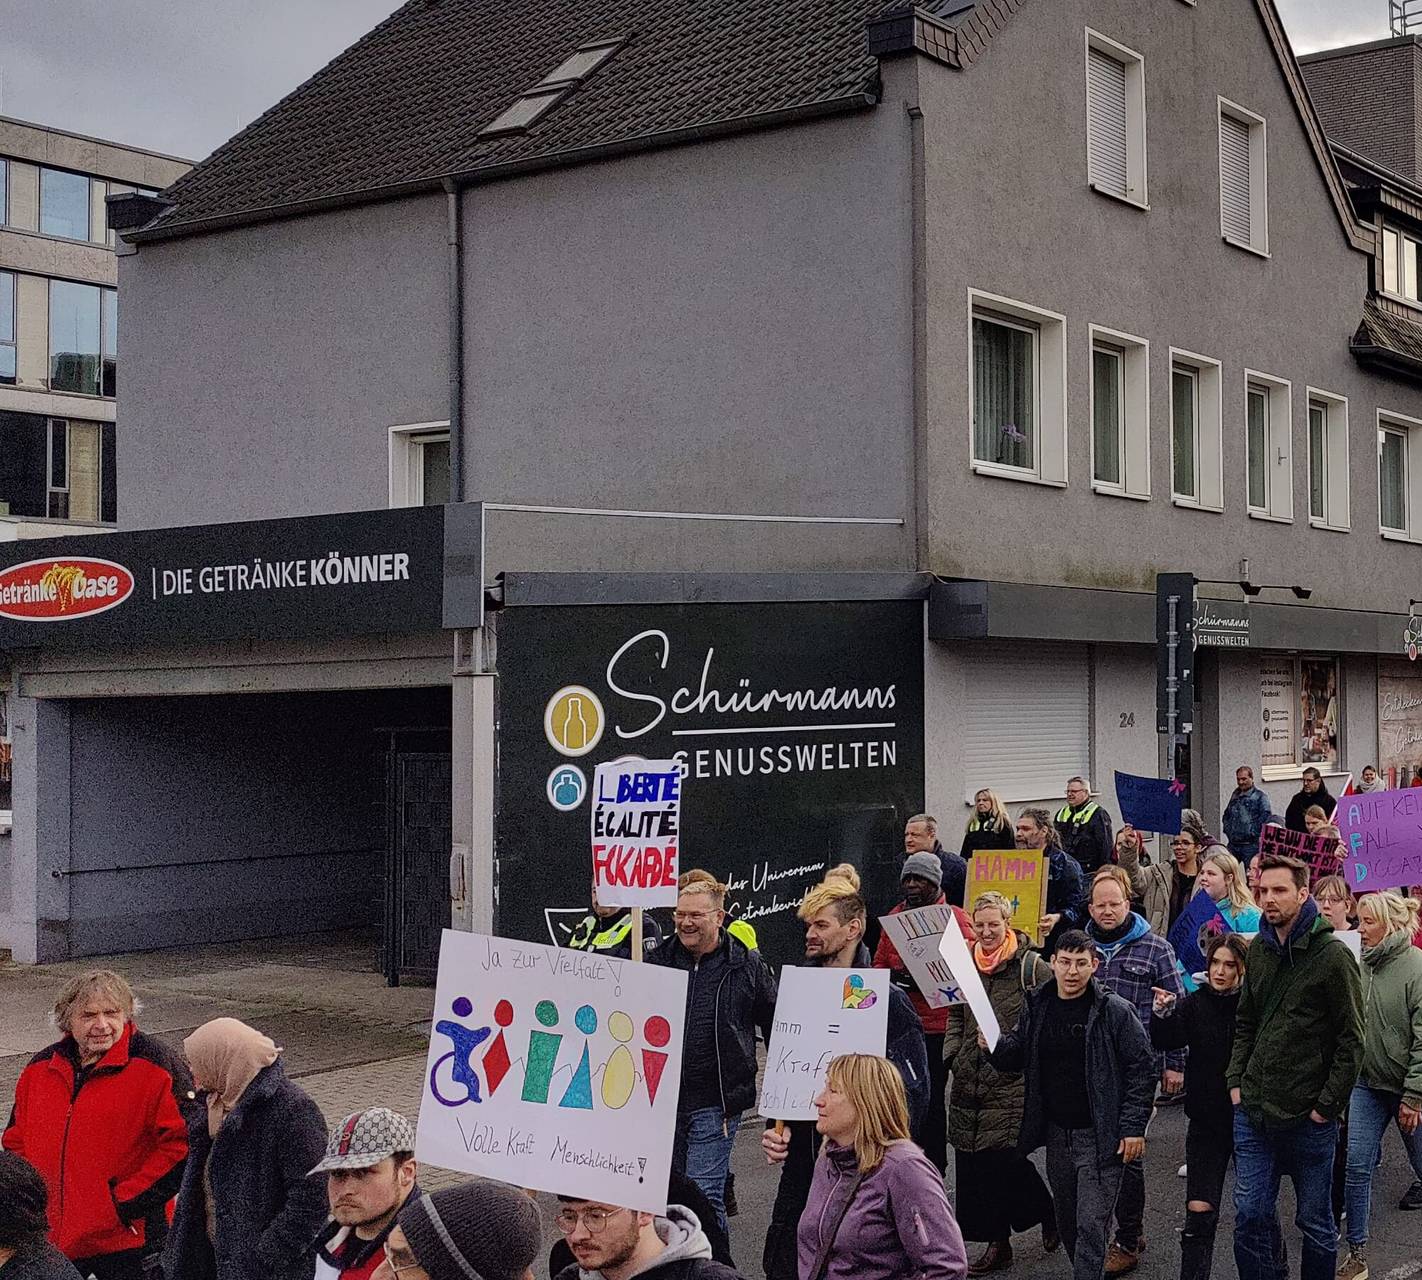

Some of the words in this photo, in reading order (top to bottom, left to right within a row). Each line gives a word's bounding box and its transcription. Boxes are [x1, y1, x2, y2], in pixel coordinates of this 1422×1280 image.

[0, 578, 57, 605] etränke
[163, 569, 193, 596] DIE
[1198, 635, 1250, 647] GENUSSWELTEN
[606, 629, 896, 738] Schürmanns
[1119, 711, 1135, 728] 24
[672, 740, 896, 779] GENUSSWELTEN
[1348, 799, 1384, 827] AUF
[1264, 825, 1302, 850] WENN
[1349, 826, 1401, 857] FALL
[724, 873, 748, 893] das
[752, 861, 825, 892] Universum
[975, 856, 1036, 881] HAMM
[482, 938, 502, 971] Ja
[512, 950, 540, 969] zur
[456, 1116, 500, 1155] Volle
[506, 1127, 535, 1156] Kraft
